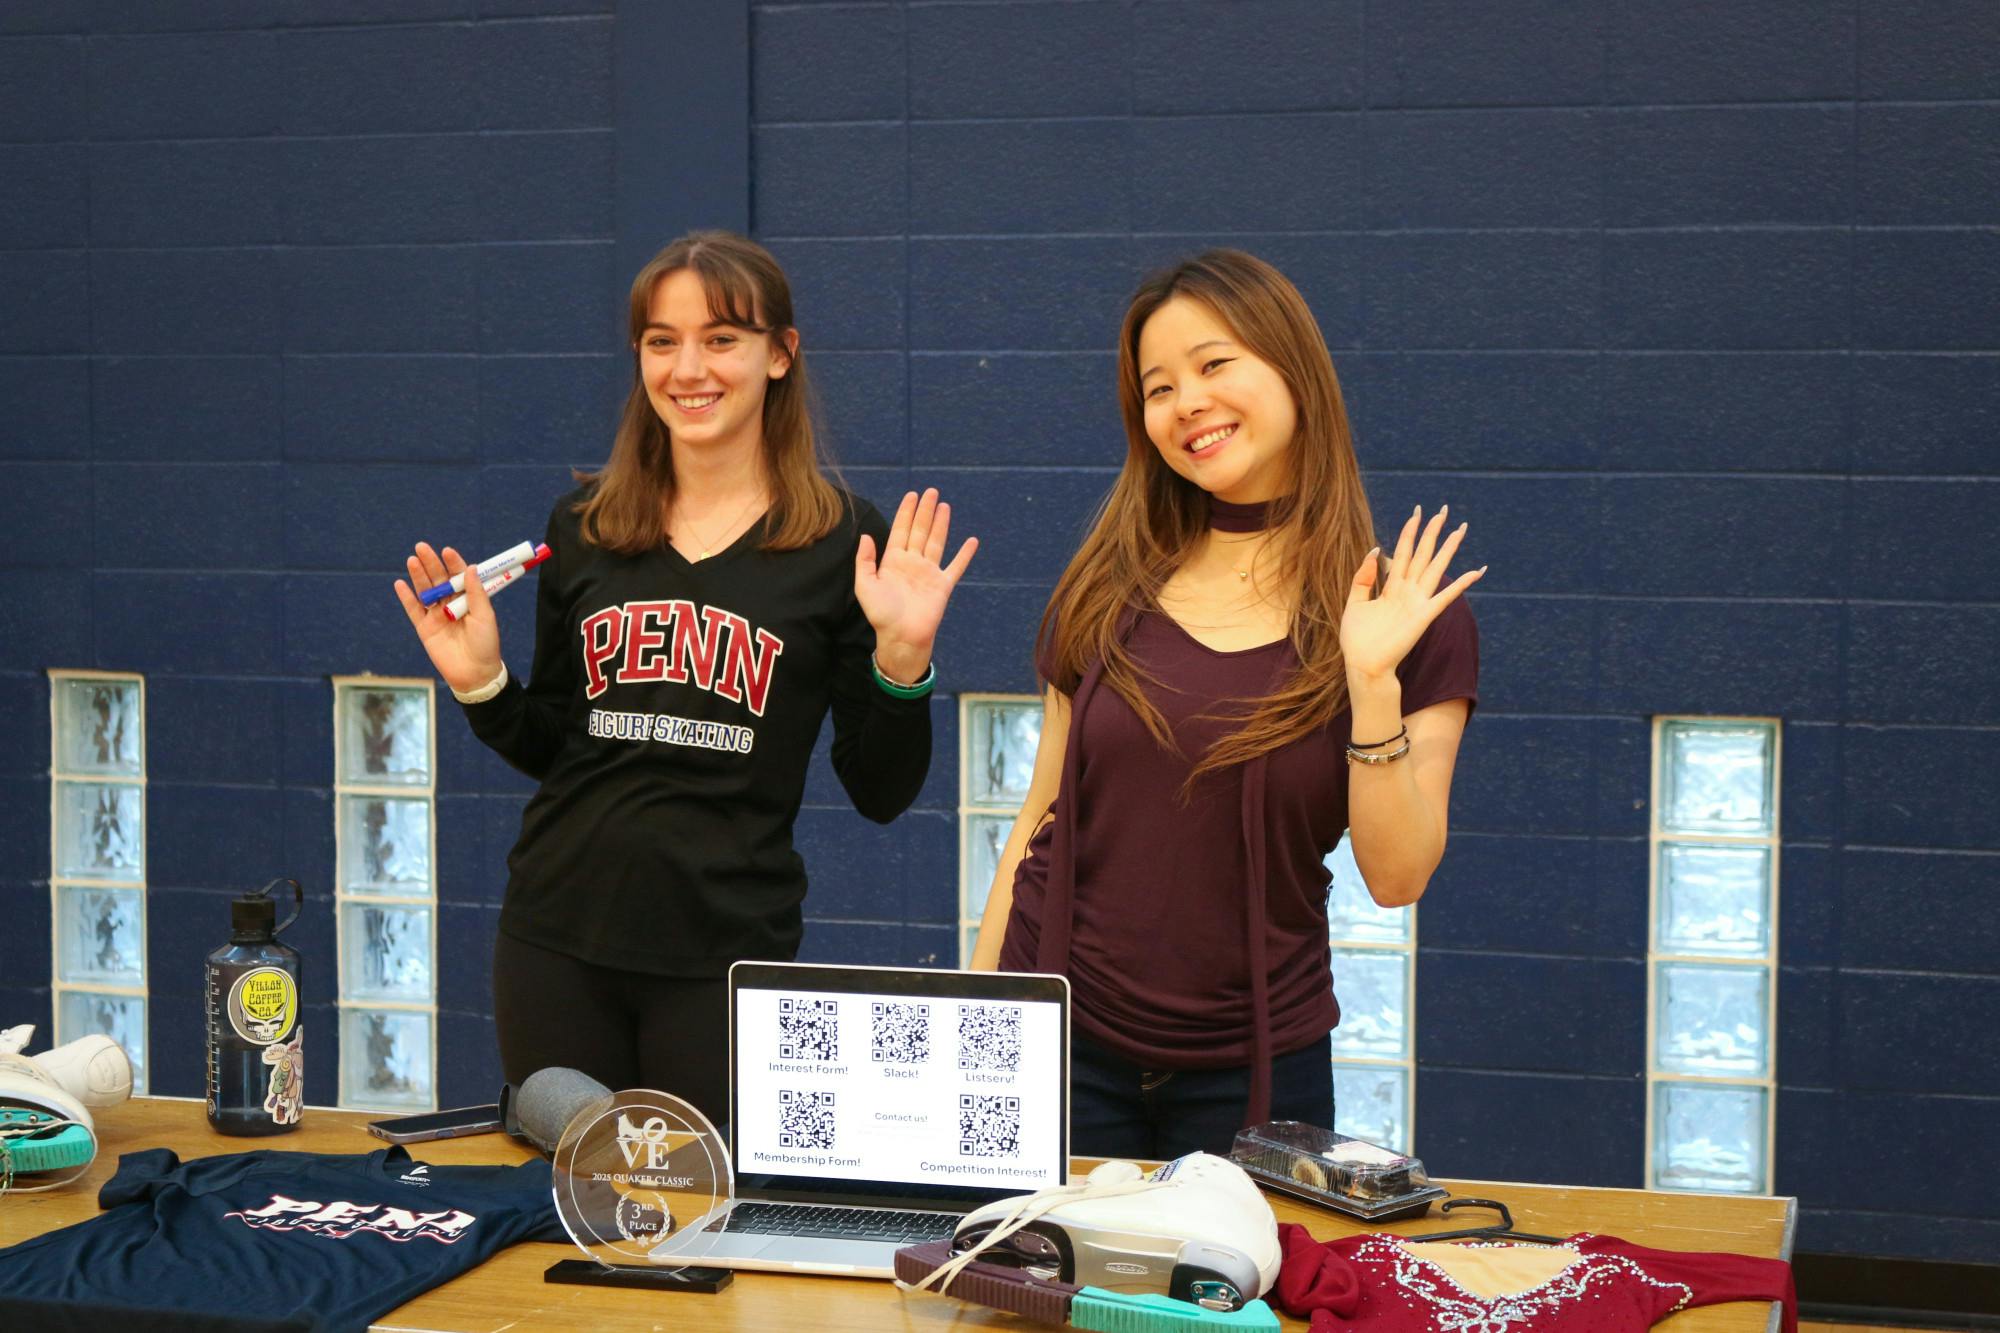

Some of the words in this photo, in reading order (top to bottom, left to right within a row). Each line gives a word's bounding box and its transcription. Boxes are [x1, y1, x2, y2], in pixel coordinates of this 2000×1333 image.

[581, 599, 784, 717] PENN
[653, 714, 754, 754] SKATING
[249, 993, 282, 1005] COFFEE
[769, 1062, 812, 1075] Interest
[816, 1063, 849, 1076] Form!
[883, 1067, 919, 1080] Slack!
[965, 1072, 1015, 1084] Listserv!
[874, 1112, 912, 1122] Contact
[753, 1151, 826, 1166] Membership
[828, 1155, 861, 1168] Form!
[919, 1161, 995, 1177] Competition
[997, 1165, 1047, 1179] Interest!
[613, 1173, 653, 1185] QUAKER
[655, 1176, 694, 1186] CLASSIC
[629, 1220, 658, 1232] PLACE
